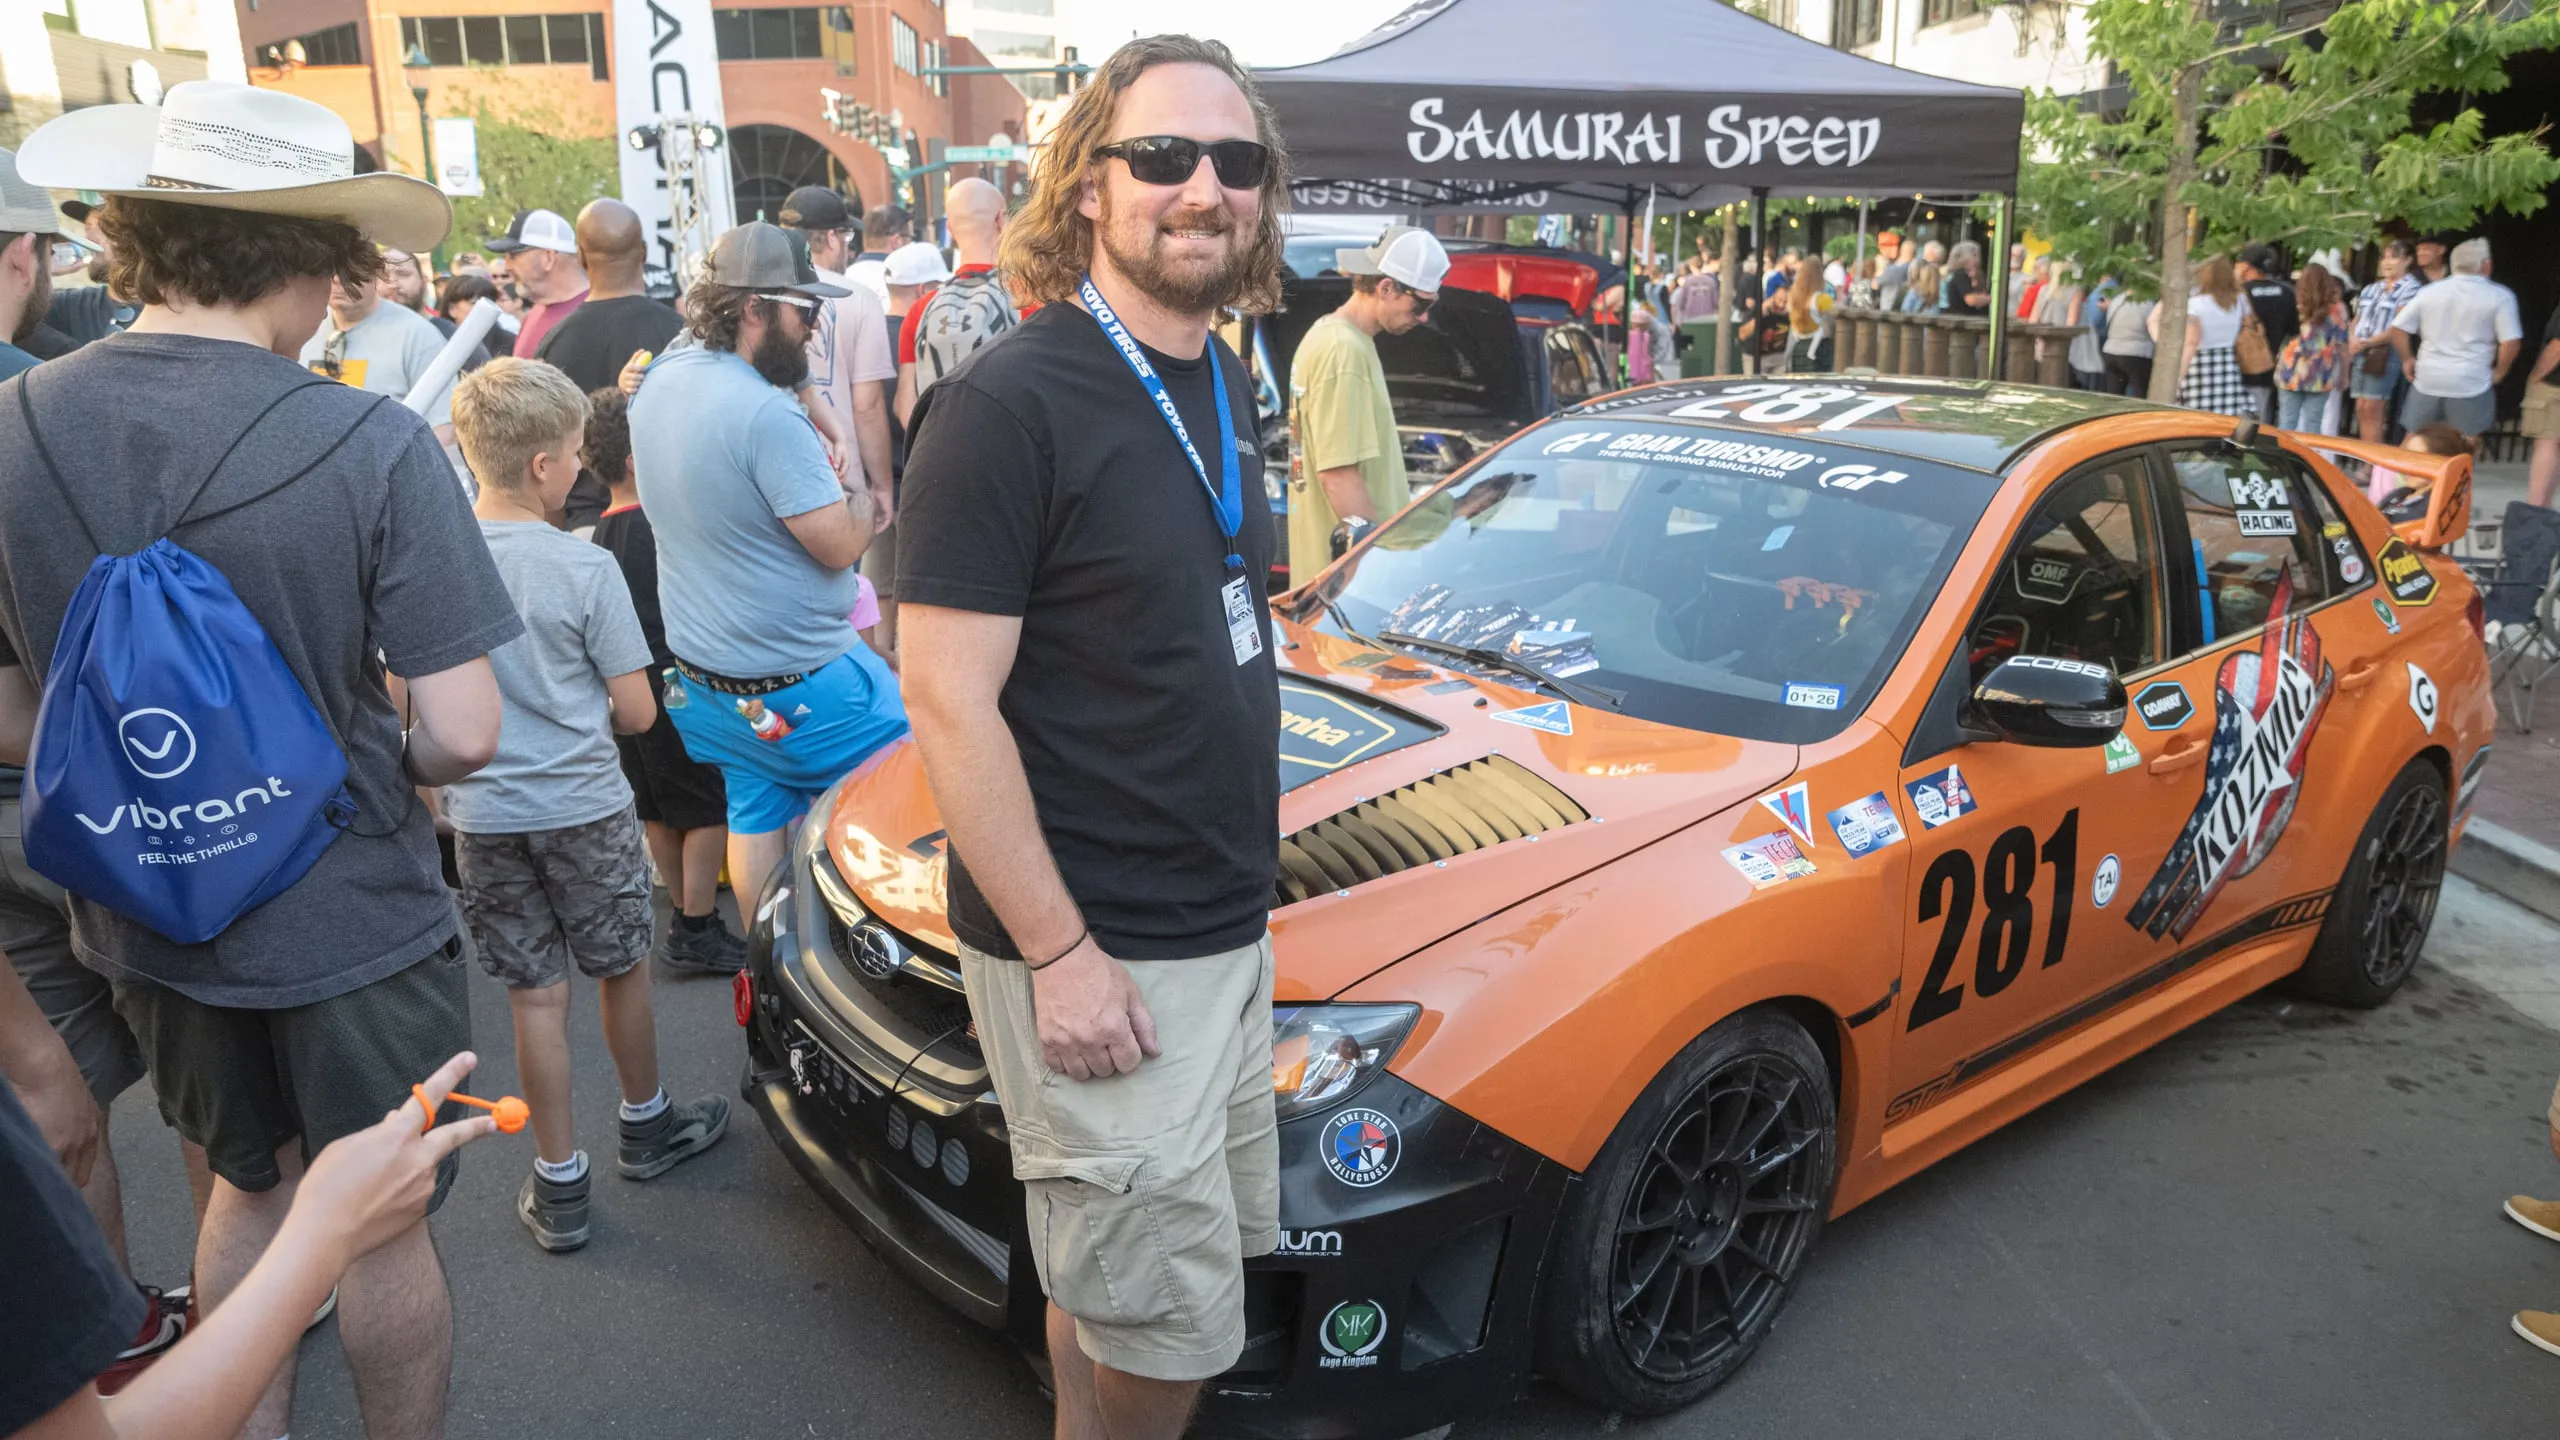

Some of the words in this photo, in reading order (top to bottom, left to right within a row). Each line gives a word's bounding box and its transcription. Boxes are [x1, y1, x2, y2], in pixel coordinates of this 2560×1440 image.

[1407, 98, 1682, 165] SAMURAI
[1705, 105, 1881, 169] SPEED
[1082, 281, 1115, 324] TOYO
[1108, 322, 1154, 378] TIRES
[1155, 389, 1189, 443] TOYO
[1668, 384, 1915, 431] 281
[1606, 433, 1684, 454] GRAN
[1598, 449, 1620, 458] THE
[1620, 451, 1651, 461] REAL
[1653, 453, 1706, 466] DRIVING
[1706, 459, 1787, 479] SIMULATOR
[2240, 515, 2293, 531] RACING
[2030, 562, 2069, 581] OMP
[2007, 655, 2109, 679] COBB
[1790, 691, 1807, 703] 01
[1816, 693, 1836, 706] 26
[2197, 658, 2313, 886] KOZMIC
[138, 852, 170, 865] FEEL
[168, 852, 197, 865] THE
[1763, 838, 1799, 862] TECH
[1906, 807, 2080, 1034] 281
[1335, 1112, 1360, 1128] LONE
[1363, 1112, 1388, 1130] STAR
[1330, 1157, 1388, 1182] RALLYCROSS
[1320, 1356, 1341, 1368] Kage
[1342, 1355, 1377, 1368] Kingdom
